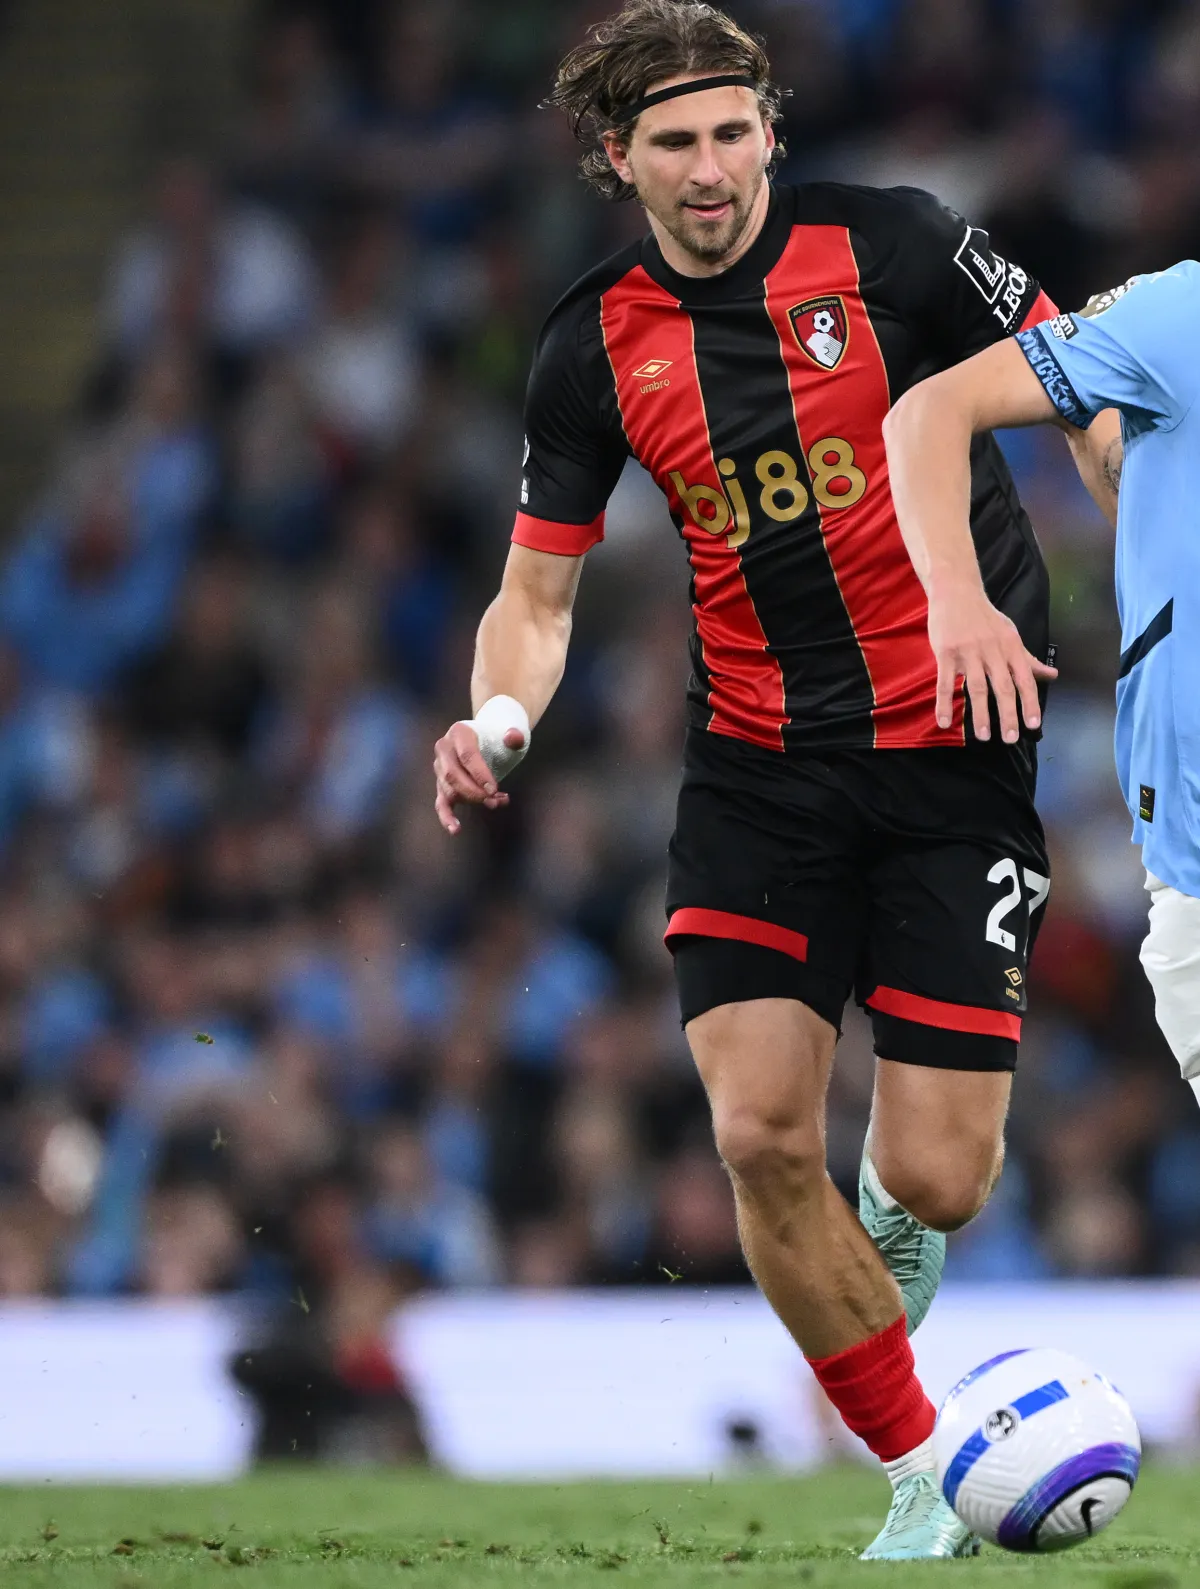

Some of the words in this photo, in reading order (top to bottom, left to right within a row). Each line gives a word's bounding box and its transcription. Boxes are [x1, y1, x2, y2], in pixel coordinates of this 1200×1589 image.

[993, 262, 1028, 329] LEOS
[640, 378, 671, 395] umbro
[668, 436, 868, 549] bj88
[985, 857, 1051, 957] 27
